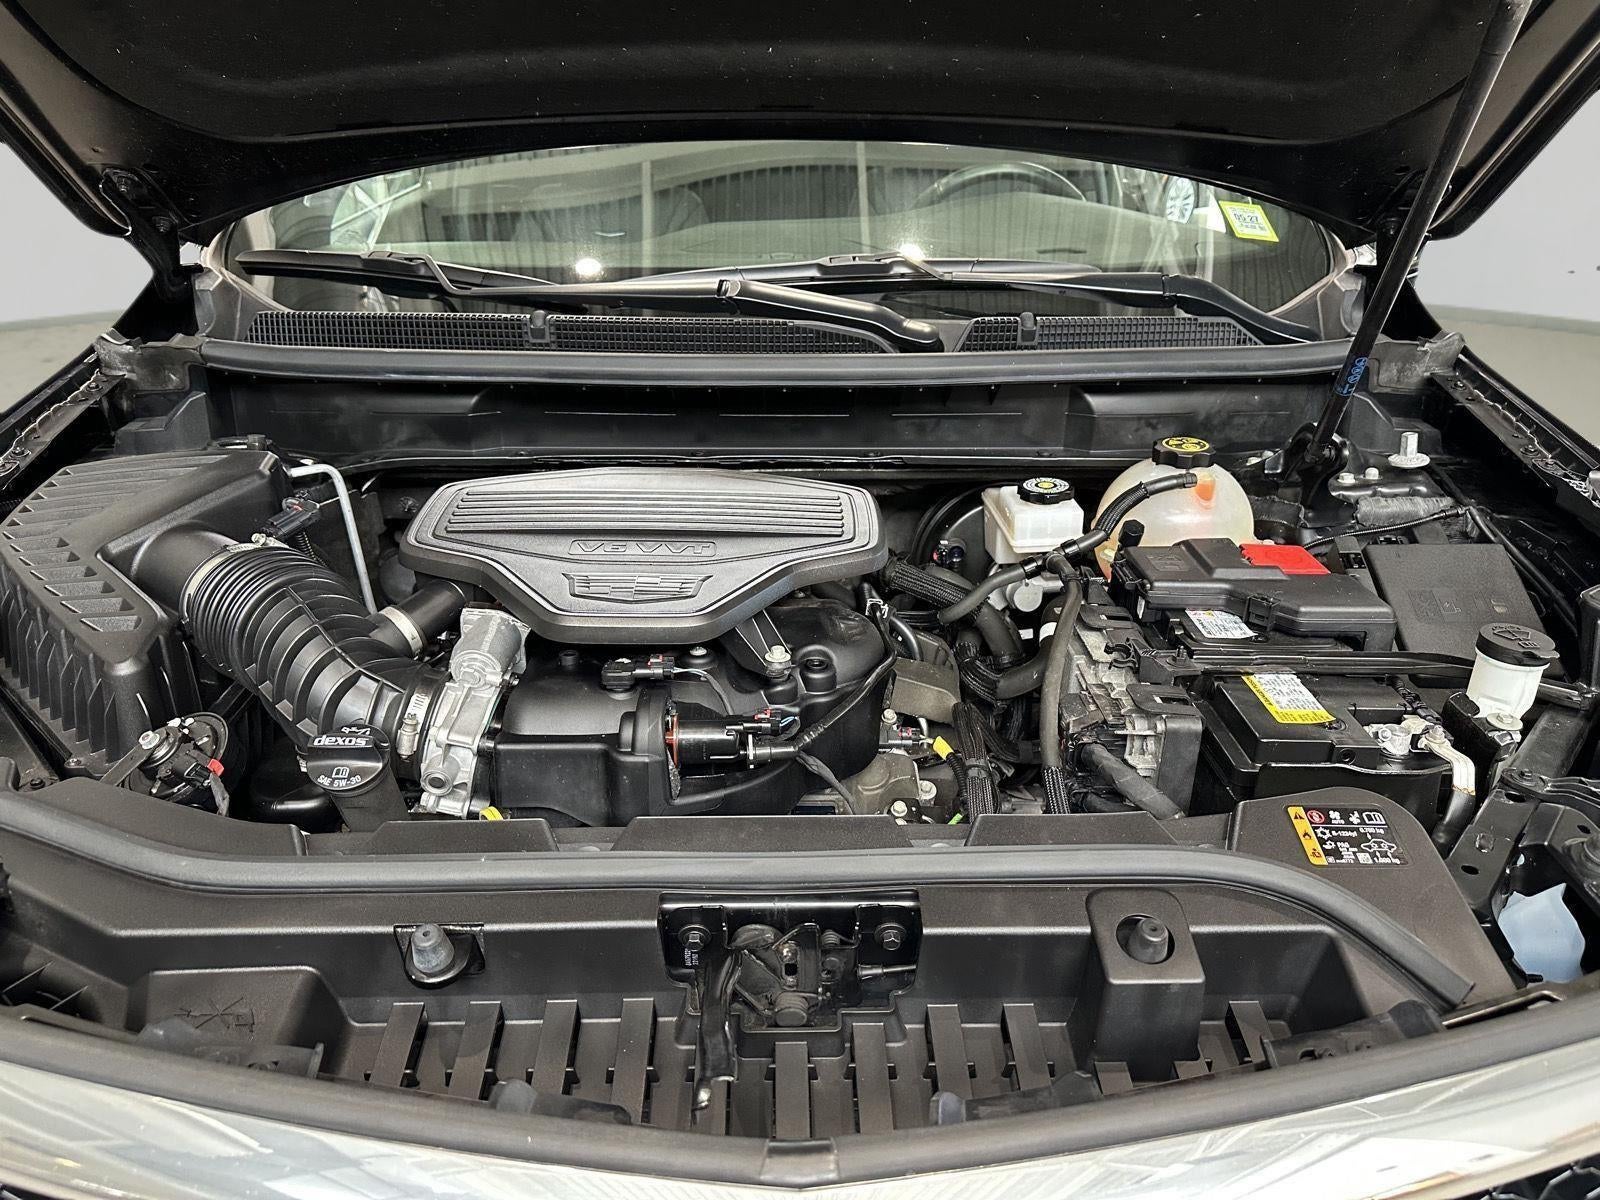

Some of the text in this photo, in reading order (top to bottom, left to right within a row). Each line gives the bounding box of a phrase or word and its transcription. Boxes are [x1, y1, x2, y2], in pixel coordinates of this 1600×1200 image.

[576, 542, 711, 555] V6 VVT
[313, 735, 370, 746] dexos
[317, 774, 362, 787] SAE 5W-30
